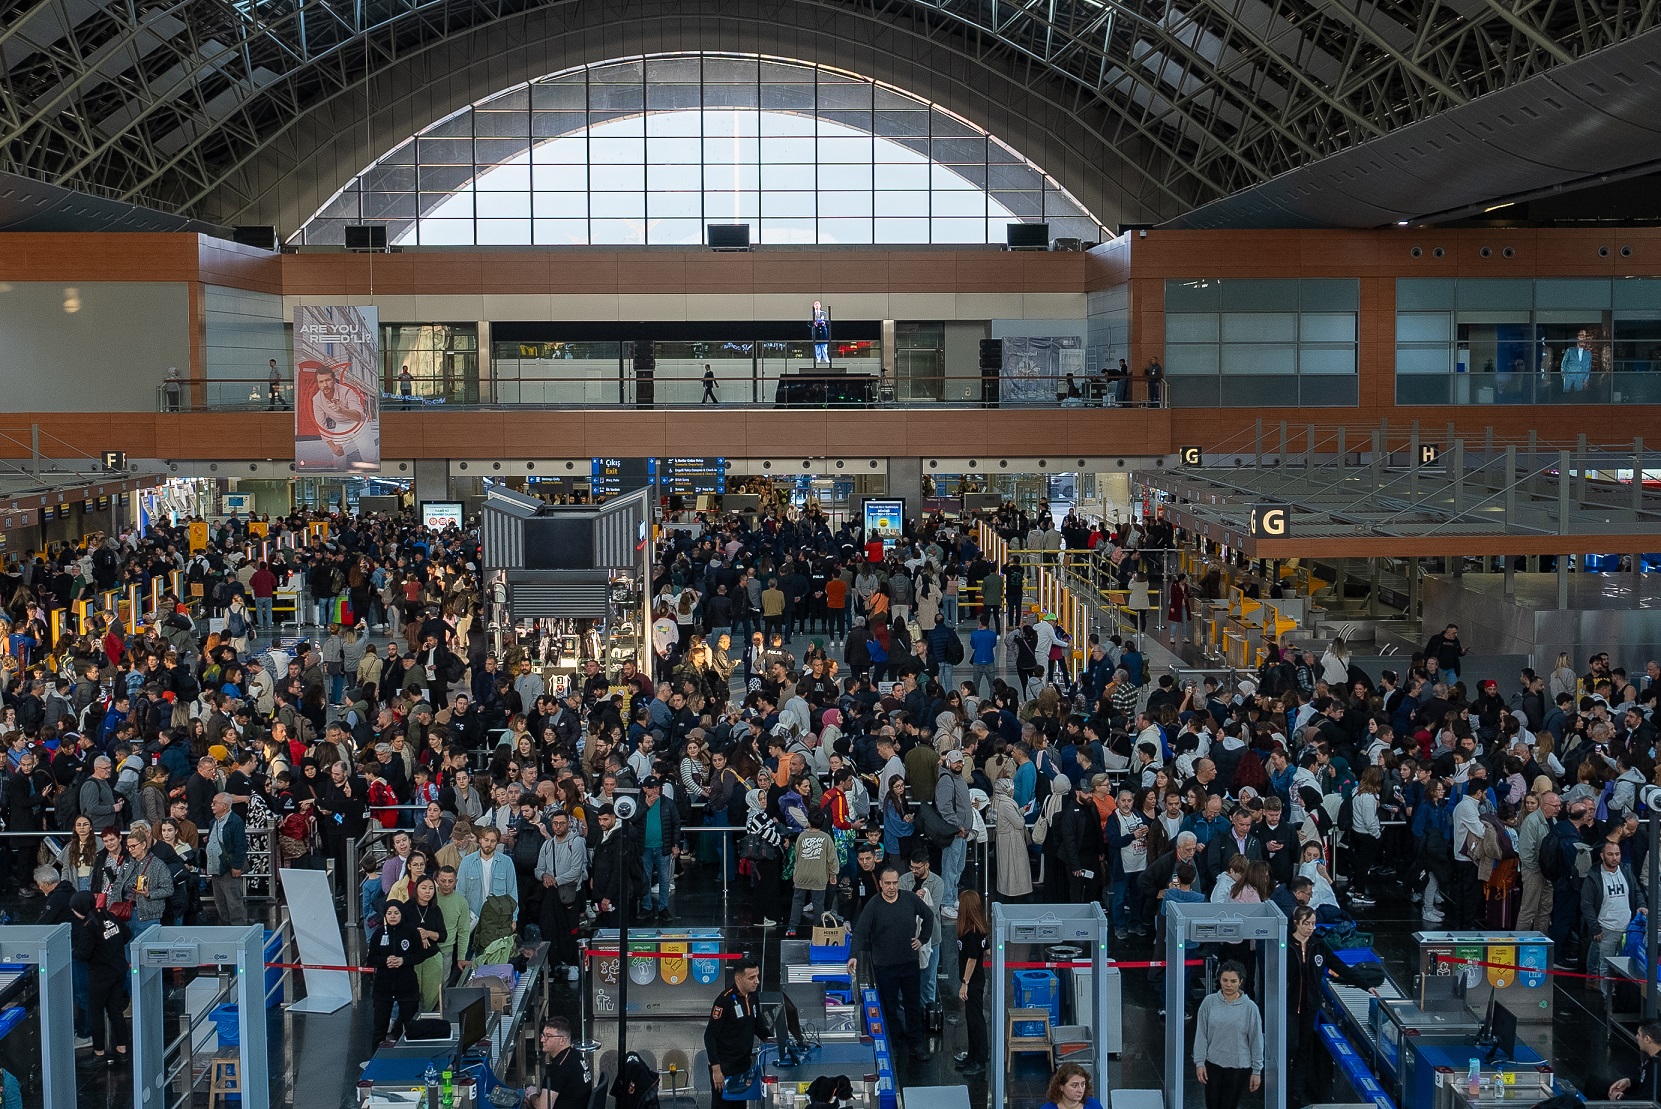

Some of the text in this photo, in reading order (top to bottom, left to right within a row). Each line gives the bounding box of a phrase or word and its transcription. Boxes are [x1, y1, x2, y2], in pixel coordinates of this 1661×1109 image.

[300, 324, 358, 333] ARE YOU
[107, 453, 116, 469] F
[1186, 448, 1198, 464] G
[1422, 446, 1434, 462] H
[1263, 509, 1285, 534] G
[1607, 884, 1625, 895] HH
